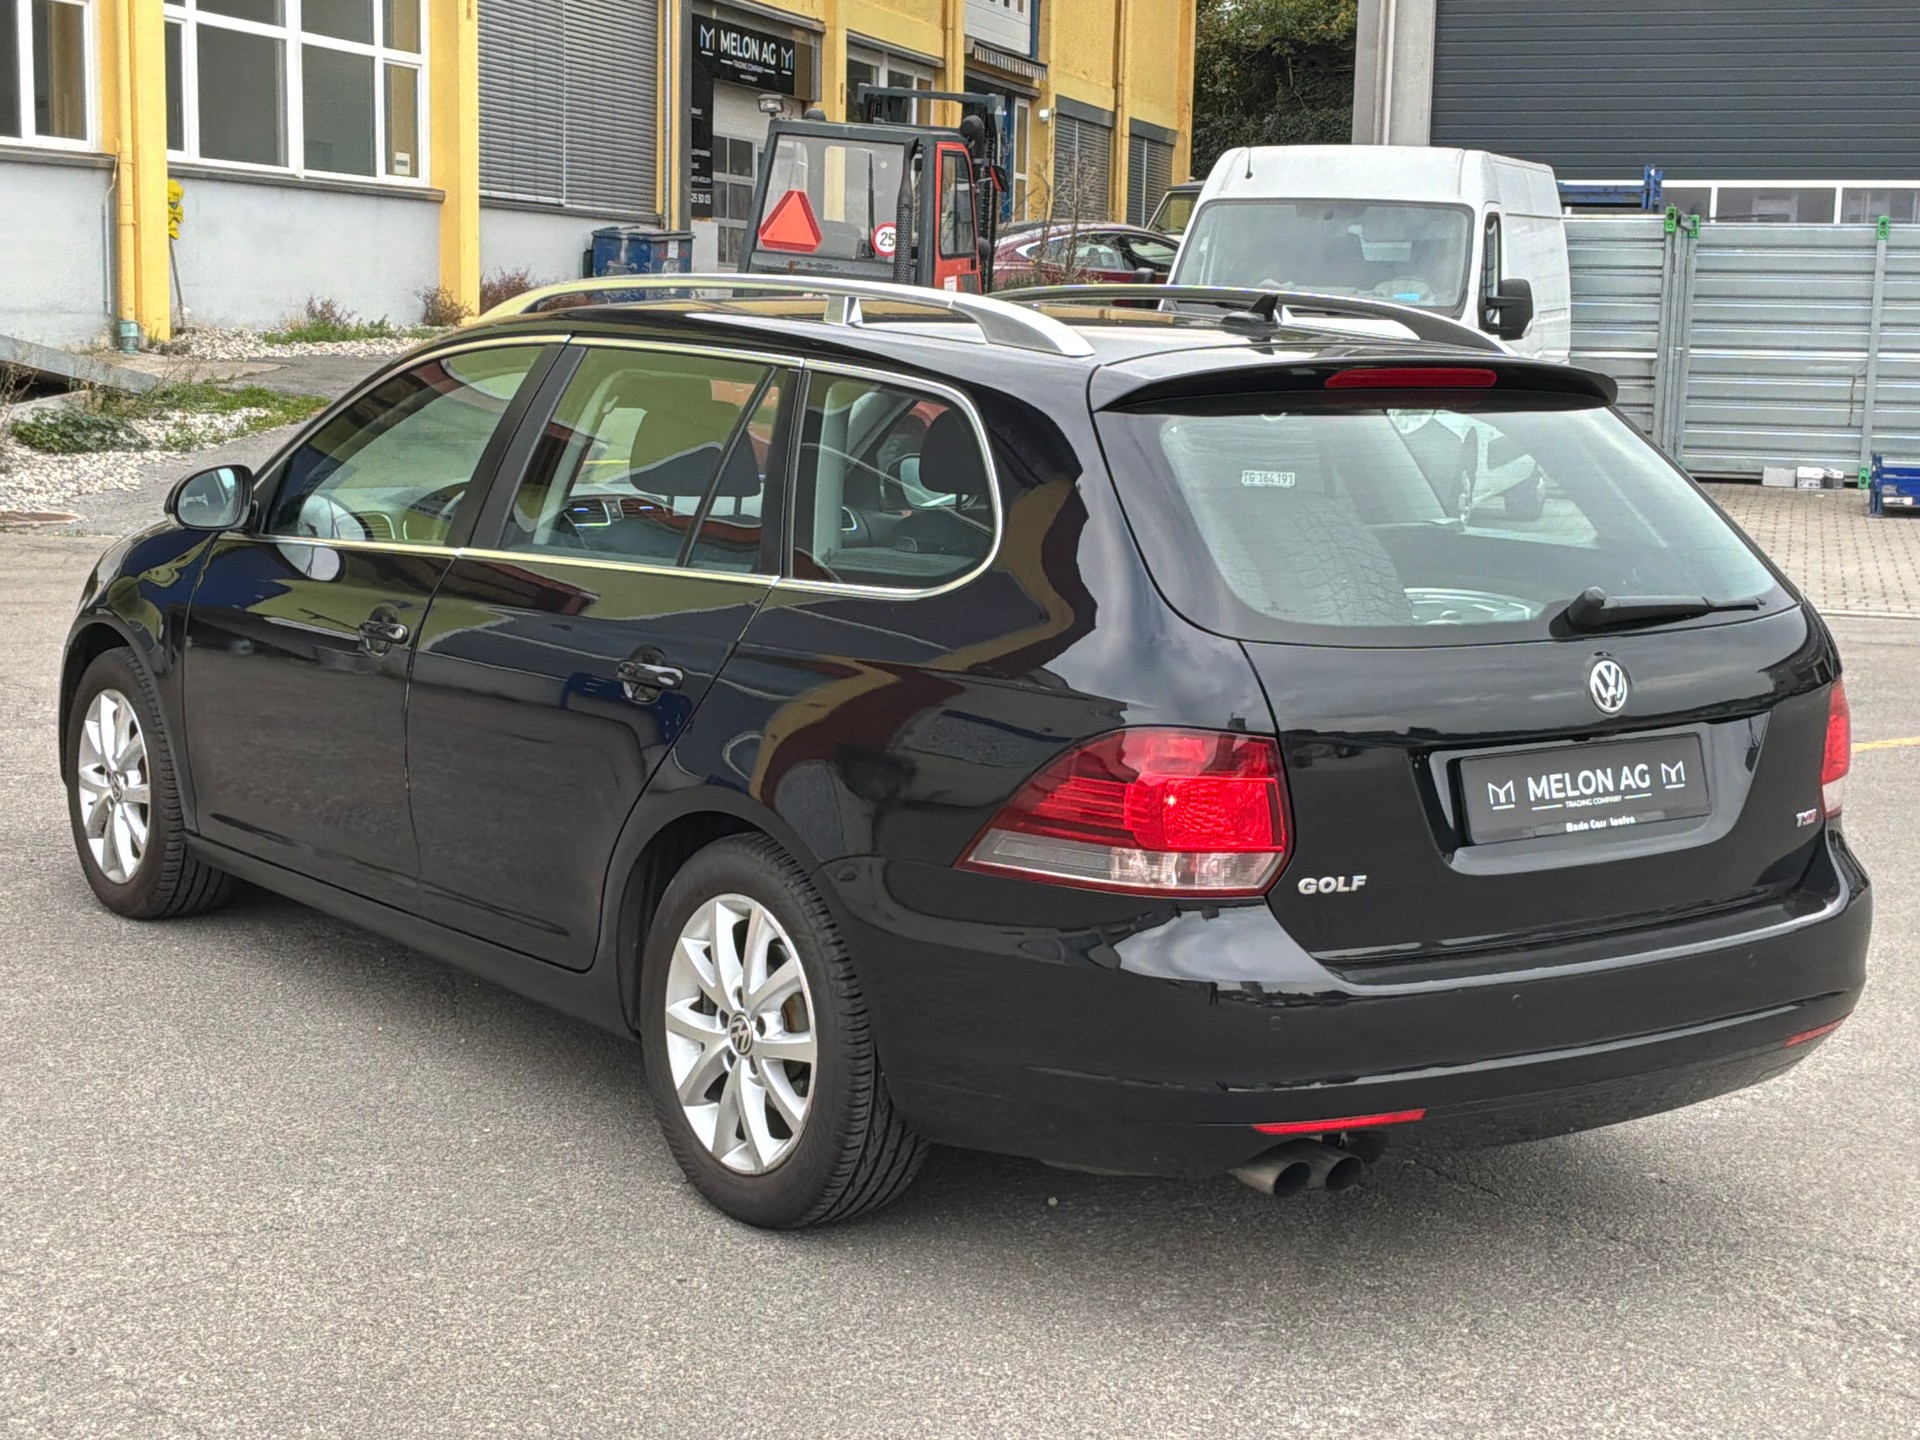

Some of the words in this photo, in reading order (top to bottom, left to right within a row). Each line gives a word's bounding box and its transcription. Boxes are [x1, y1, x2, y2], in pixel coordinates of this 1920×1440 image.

[720, 29, 760, 61] MELON
[761, 41, 777, 65] AG
[879, 232, 896, 247] 25
[1526, 767, 1614, 802] MELON
[1619, 763, 1651, 790] AG
[1565, 798, 1593, 809] TRADING
[1593, 795, 1622, 805] COMPANY
[1298, 875, 1367, 894] GOLF
